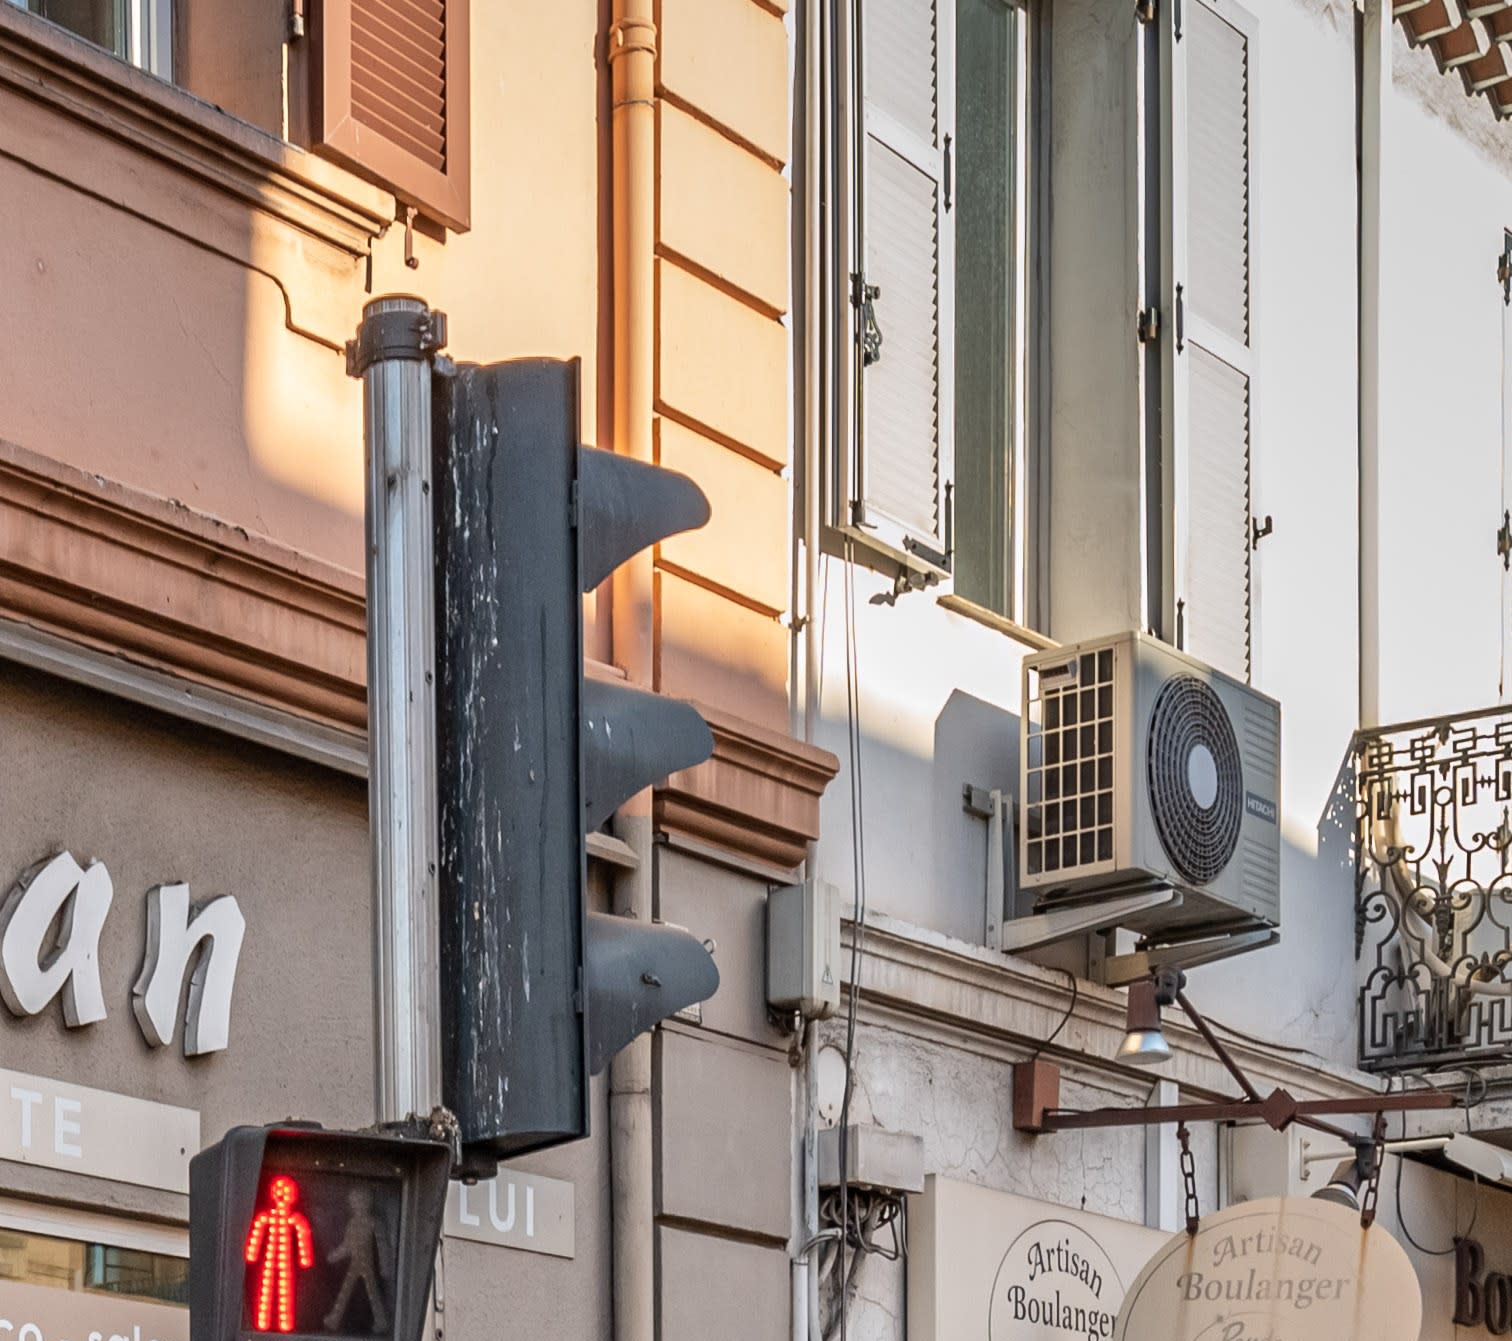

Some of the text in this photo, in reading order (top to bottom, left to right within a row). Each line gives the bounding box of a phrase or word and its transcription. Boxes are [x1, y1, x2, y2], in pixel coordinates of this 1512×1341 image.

[1247, 797, 1276, 822] HITACHI
[459, 1183, 536, 1237] LUI
[1027, 1238, 1104, 1299] Artisan
[1211, 1224, 1323, 1269] Artisan
[1176, 1267, 1351, 1311] Boulanger
